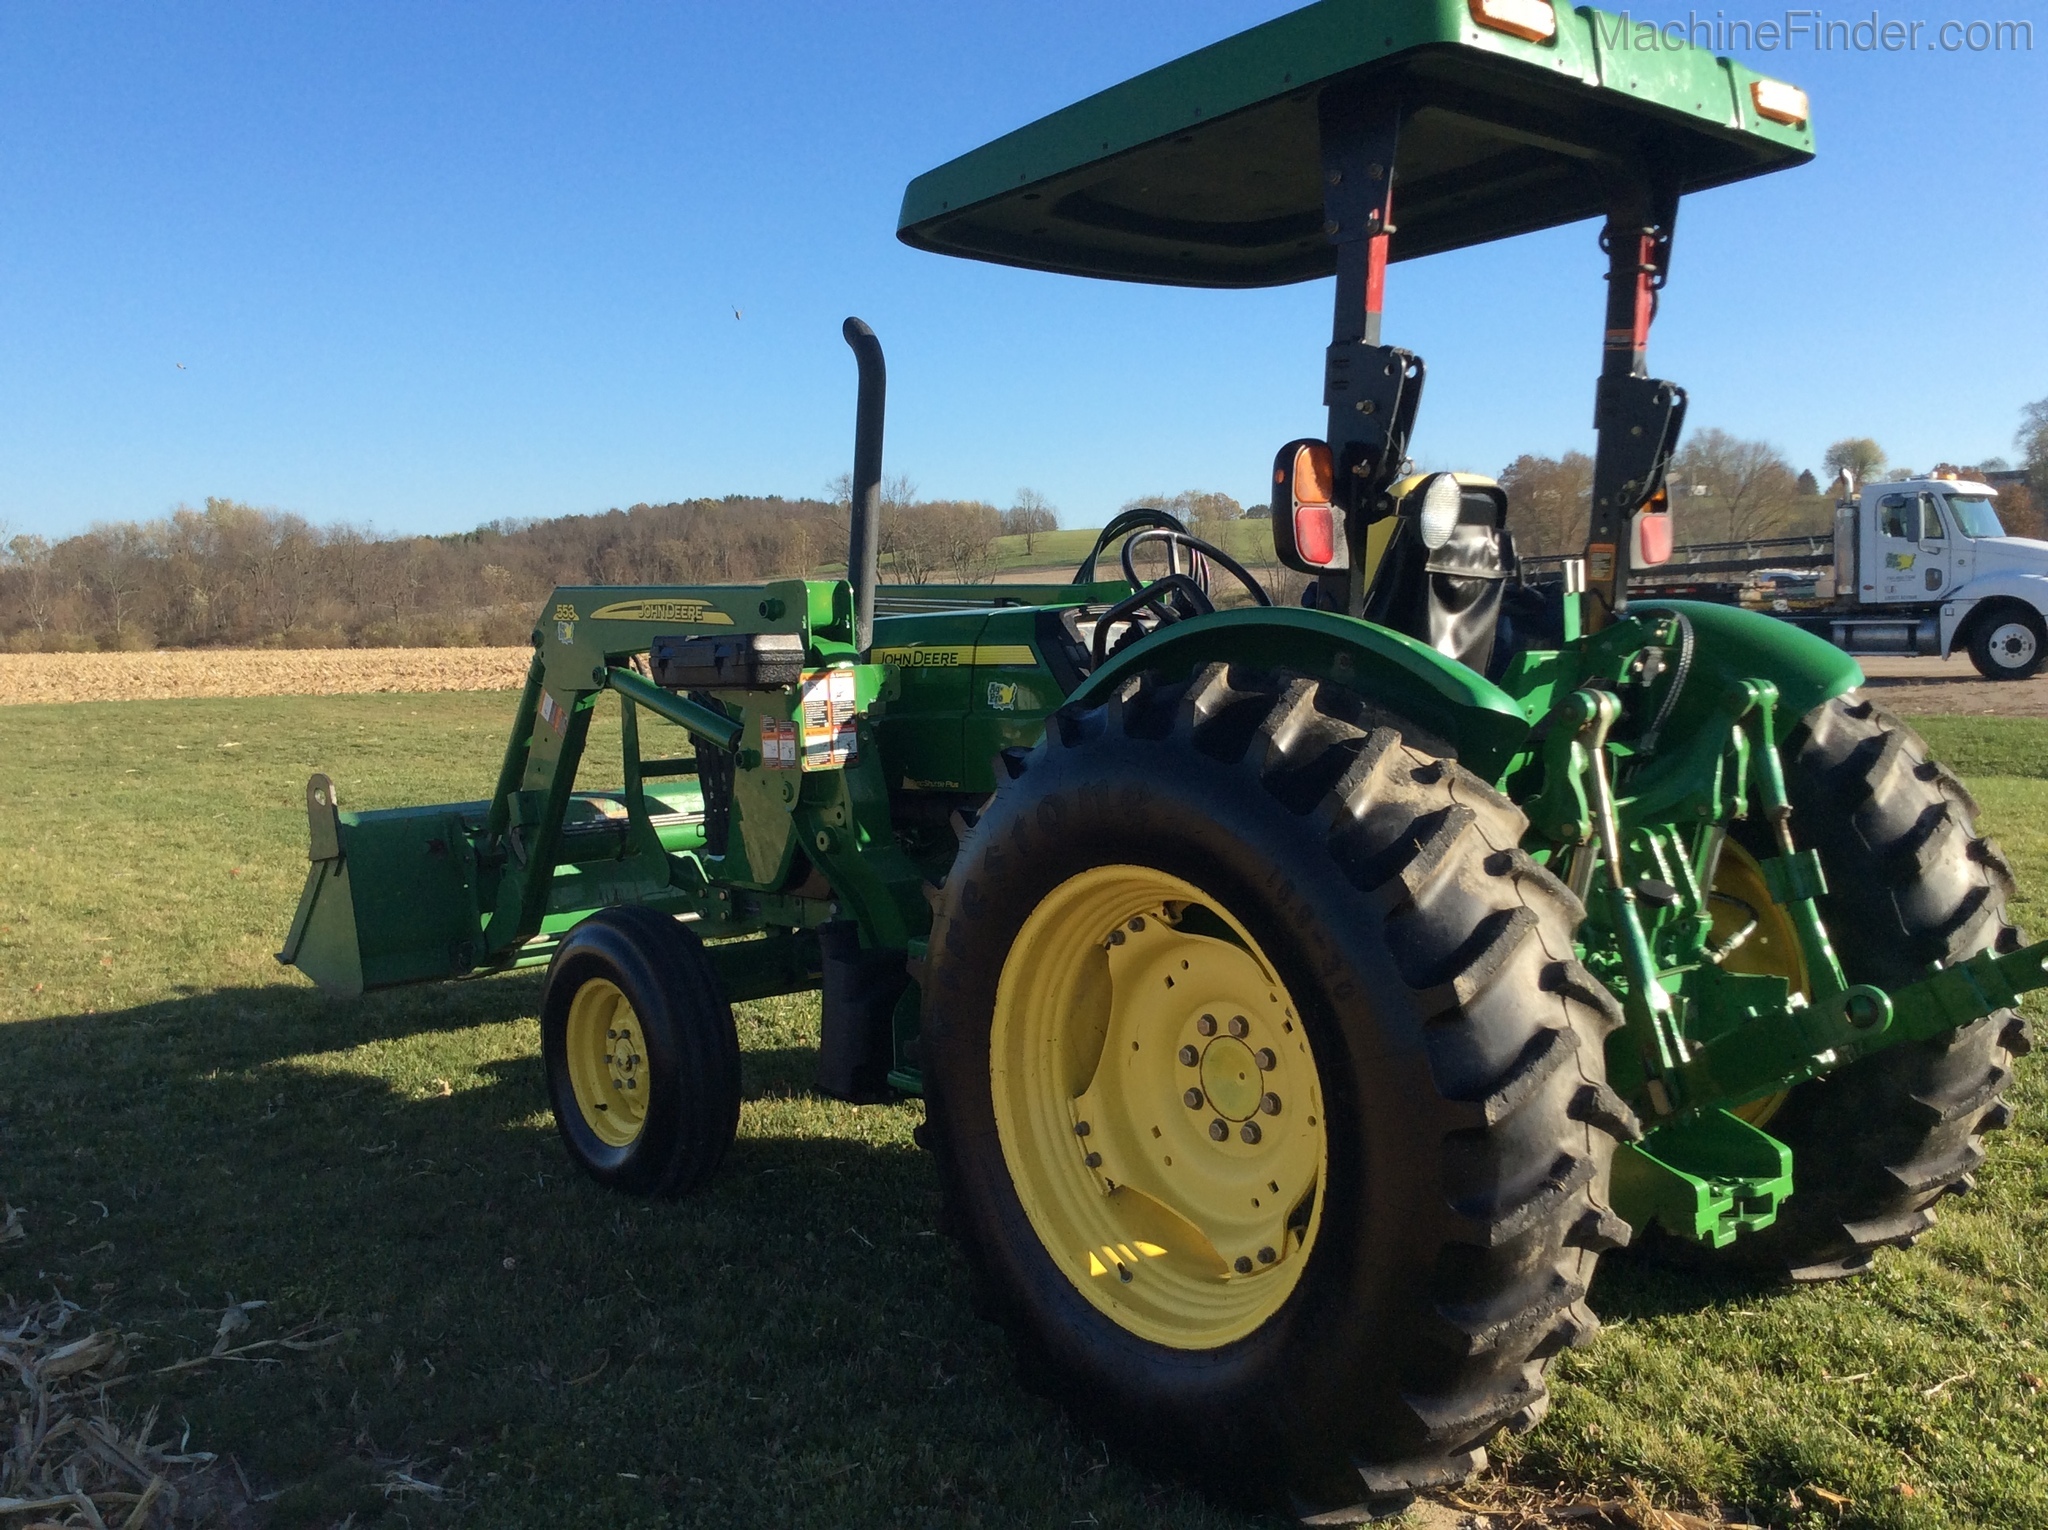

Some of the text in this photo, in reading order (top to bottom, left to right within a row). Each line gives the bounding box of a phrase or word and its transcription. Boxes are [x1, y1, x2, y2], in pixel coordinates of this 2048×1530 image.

[556, 604, 575, 619] 553
[639, 602, 703, 620] JOHN DEERE
[881, 651, 959, 665] JOHN DEERE
